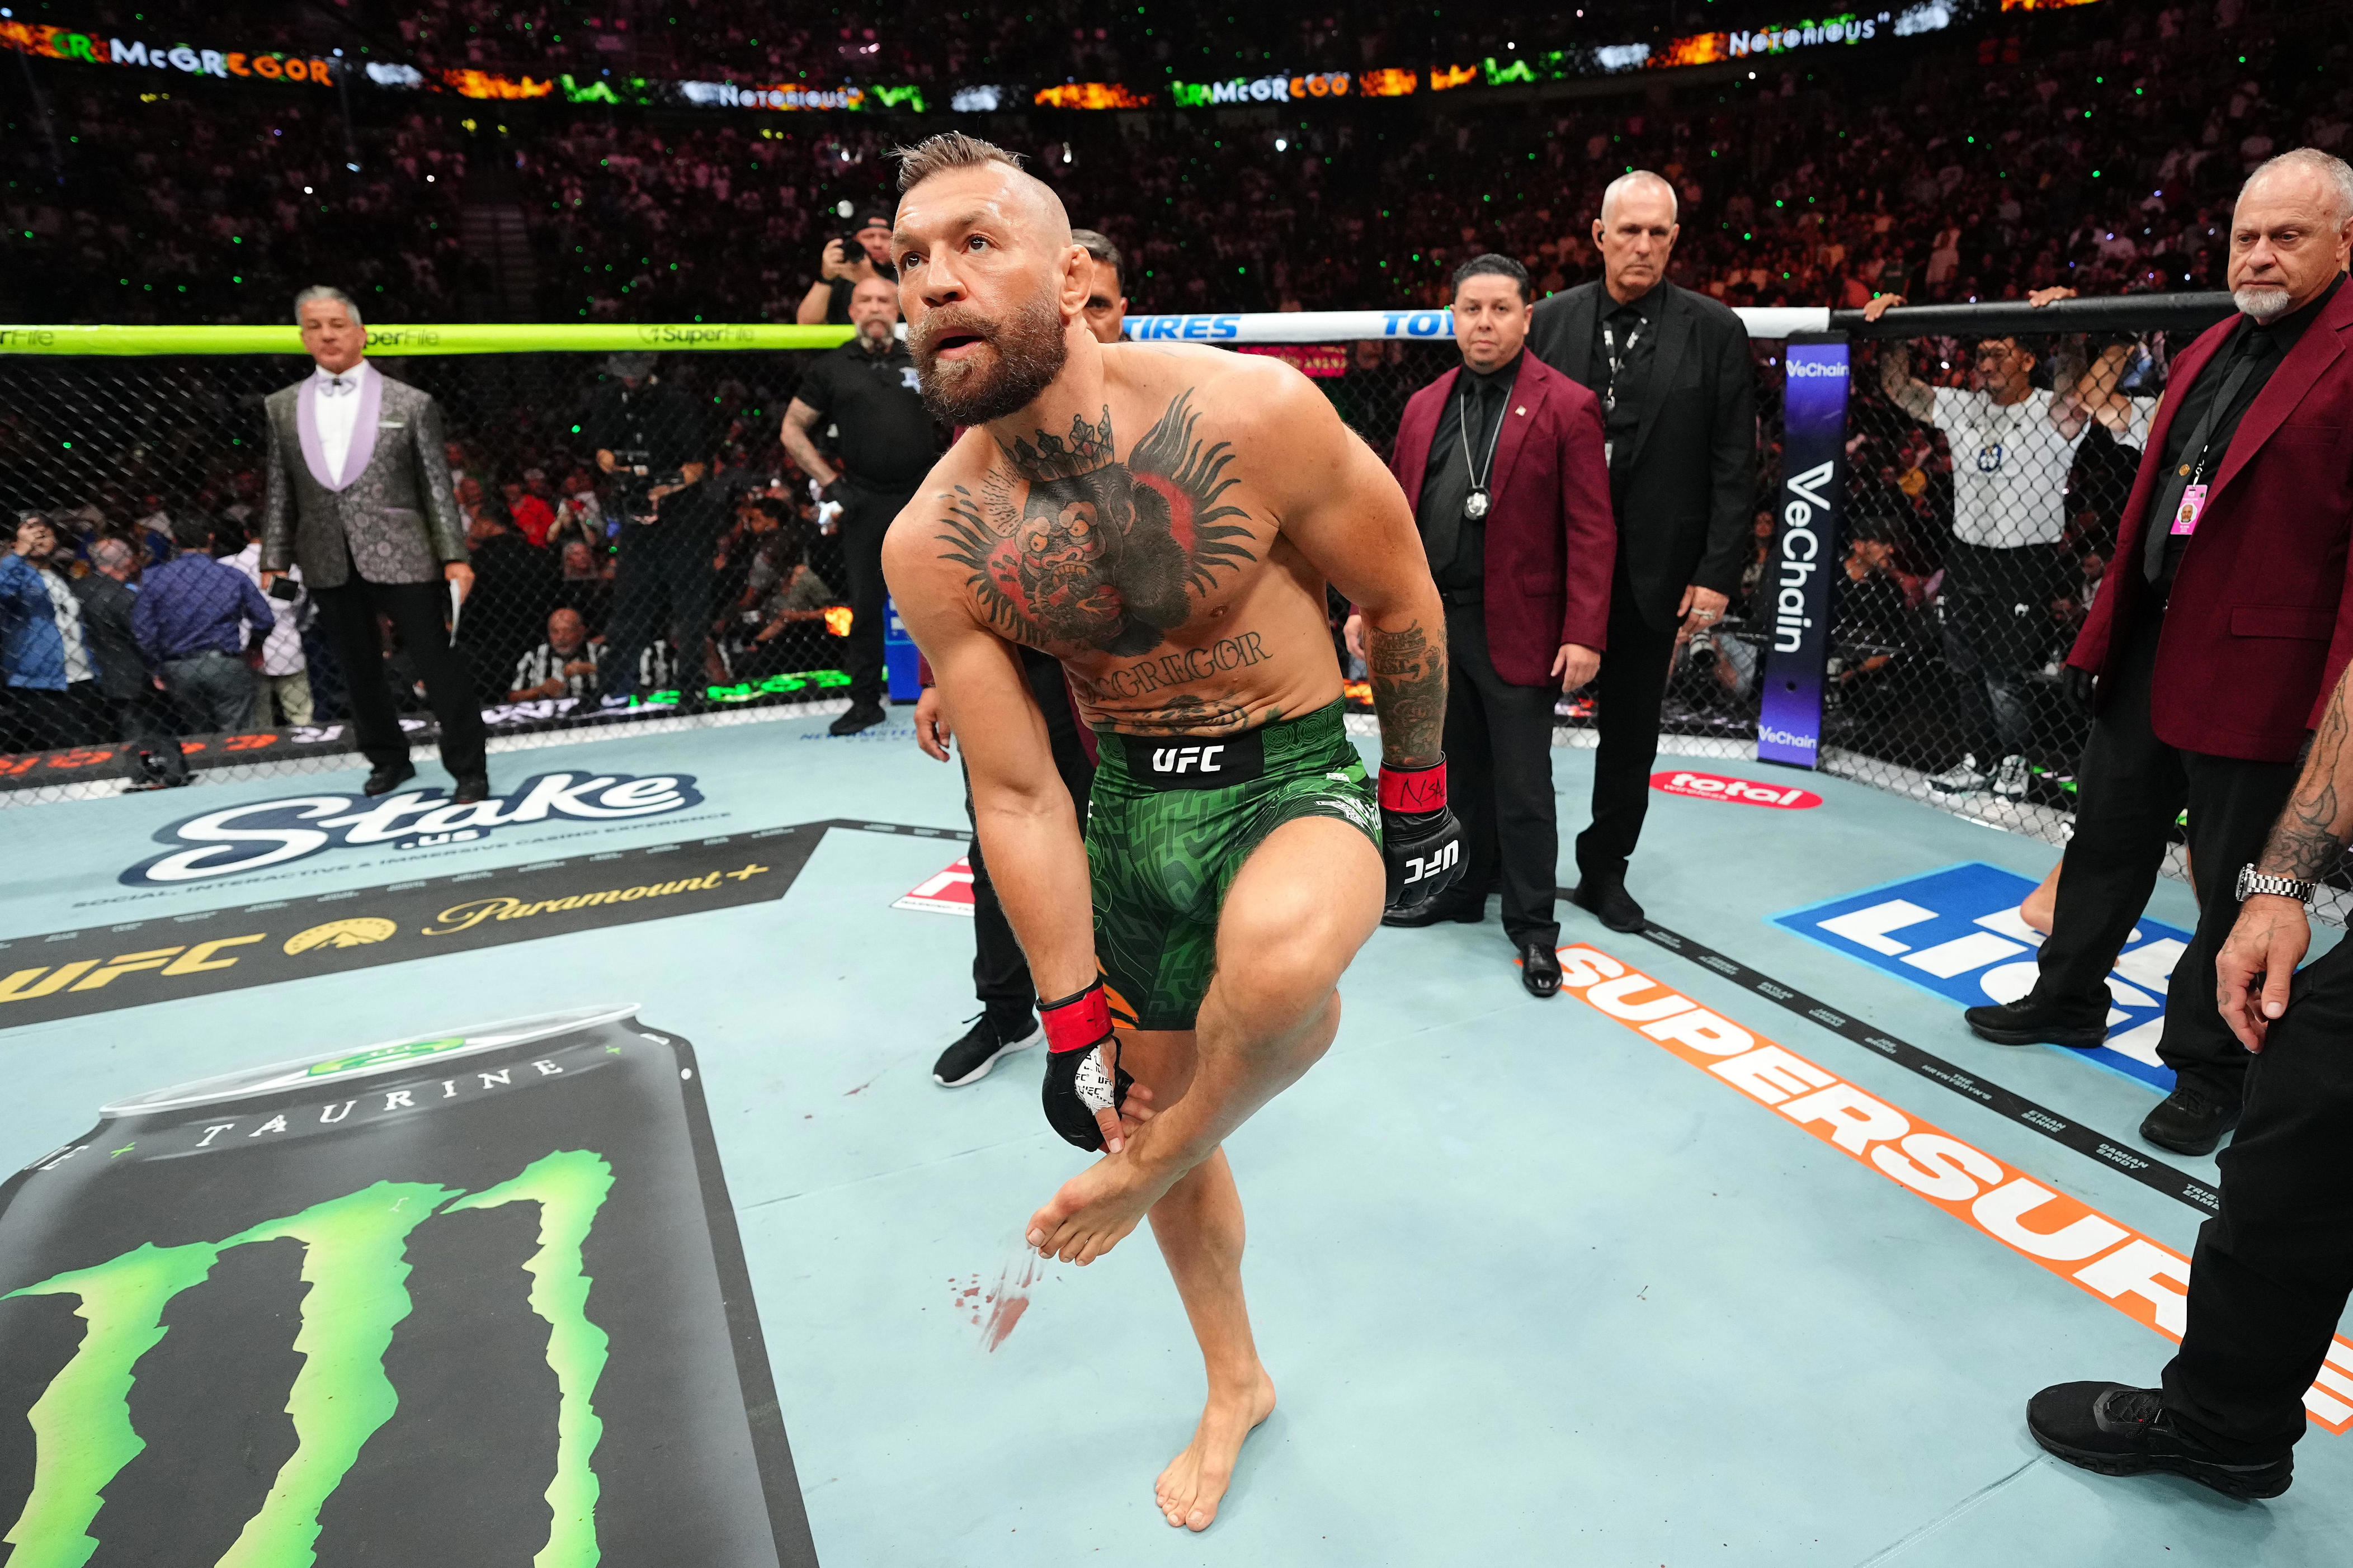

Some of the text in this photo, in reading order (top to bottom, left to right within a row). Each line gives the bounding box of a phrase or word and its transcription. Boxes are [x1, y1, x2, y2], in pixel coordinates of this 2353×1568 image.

[1787, 359, 1850, 379] VeChain
[1774, 460, 1835, 653] VeChain
[1758, 725, 1817, 748] VeChain
[1152, 745, 1224, 773] UFC
[1671, 773, 1804, 806] total
[144, 772, 686, 881] Stake
[186, 865, 353, 893] INTERACTIVE
[515, 829, 600, 846] CASINO
[604, 811, 732, 833] EXPERIENCE
[1404, 839, 1459, 885] UFC
[0, 933, 267, 1003] UFC
[196, 1059, 564, 1148] TAURINE
[2027, 1109, 2067, 1130] ETHAN
[2099, 1143, 2149, 1169] DAMIAN
